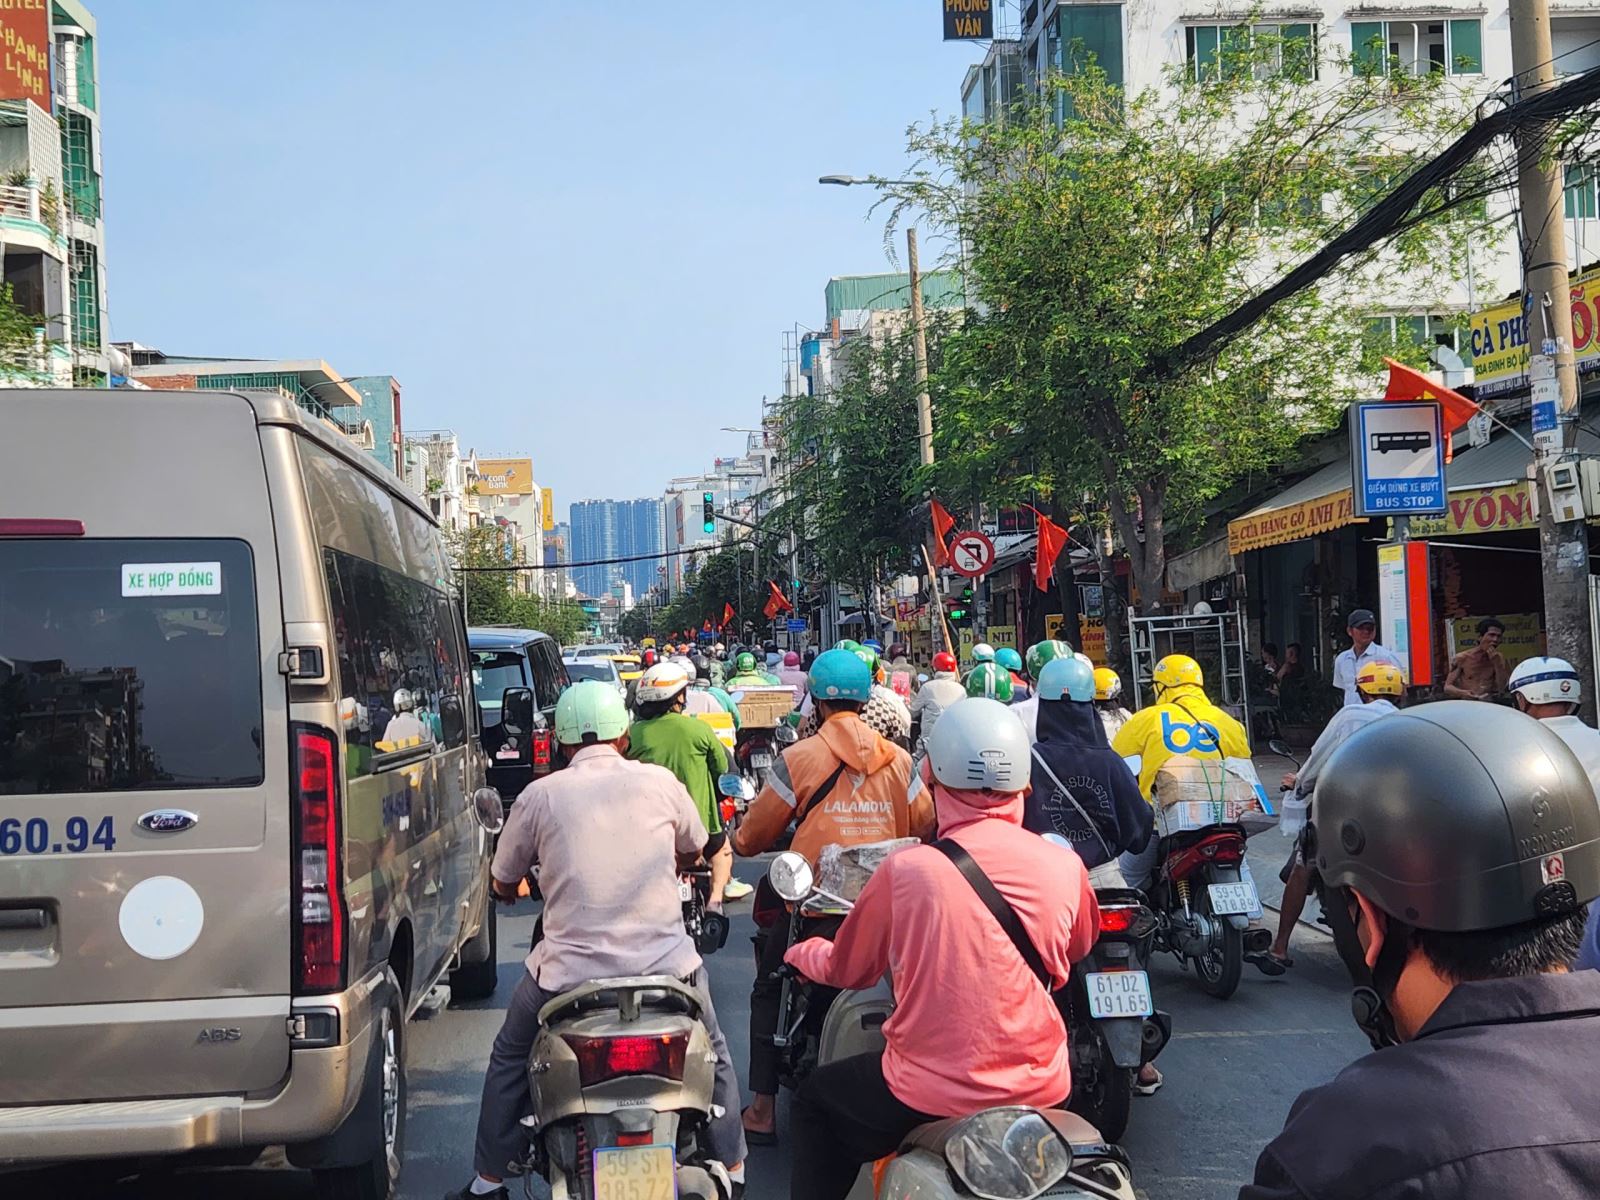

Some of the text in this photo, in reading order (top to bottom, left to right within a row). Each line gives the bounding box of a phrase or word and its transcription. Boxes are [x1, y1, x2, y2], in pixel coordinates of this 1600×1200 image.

[0, 0, 45, 9] OTEL
[955, 13, 982, 36] VÂN
[6, 52, 43, 96] LINH
[1409, 482, 1419, 493] XE
[1420, 479, 1440, 492] BUÝT
[1376, 495, 1434, 508] BUS STOP
[1307, 502, 1334, 529] ANH
[128, 573, 144, 588] XE
[149, 571, 174, 591] HỢP
[1161, 712, 1220, 754] be
[150, 813, 184, 829] Ford
[1214, 885, 1247, 899] 59-C1
[1096, 974, 1140, 993] 61-D2
[1094, 994, 1149, 1014] 191.65
[196, 1027, 241, 1042] ABS
[606, 1151, 661, 1177] 59-S1
